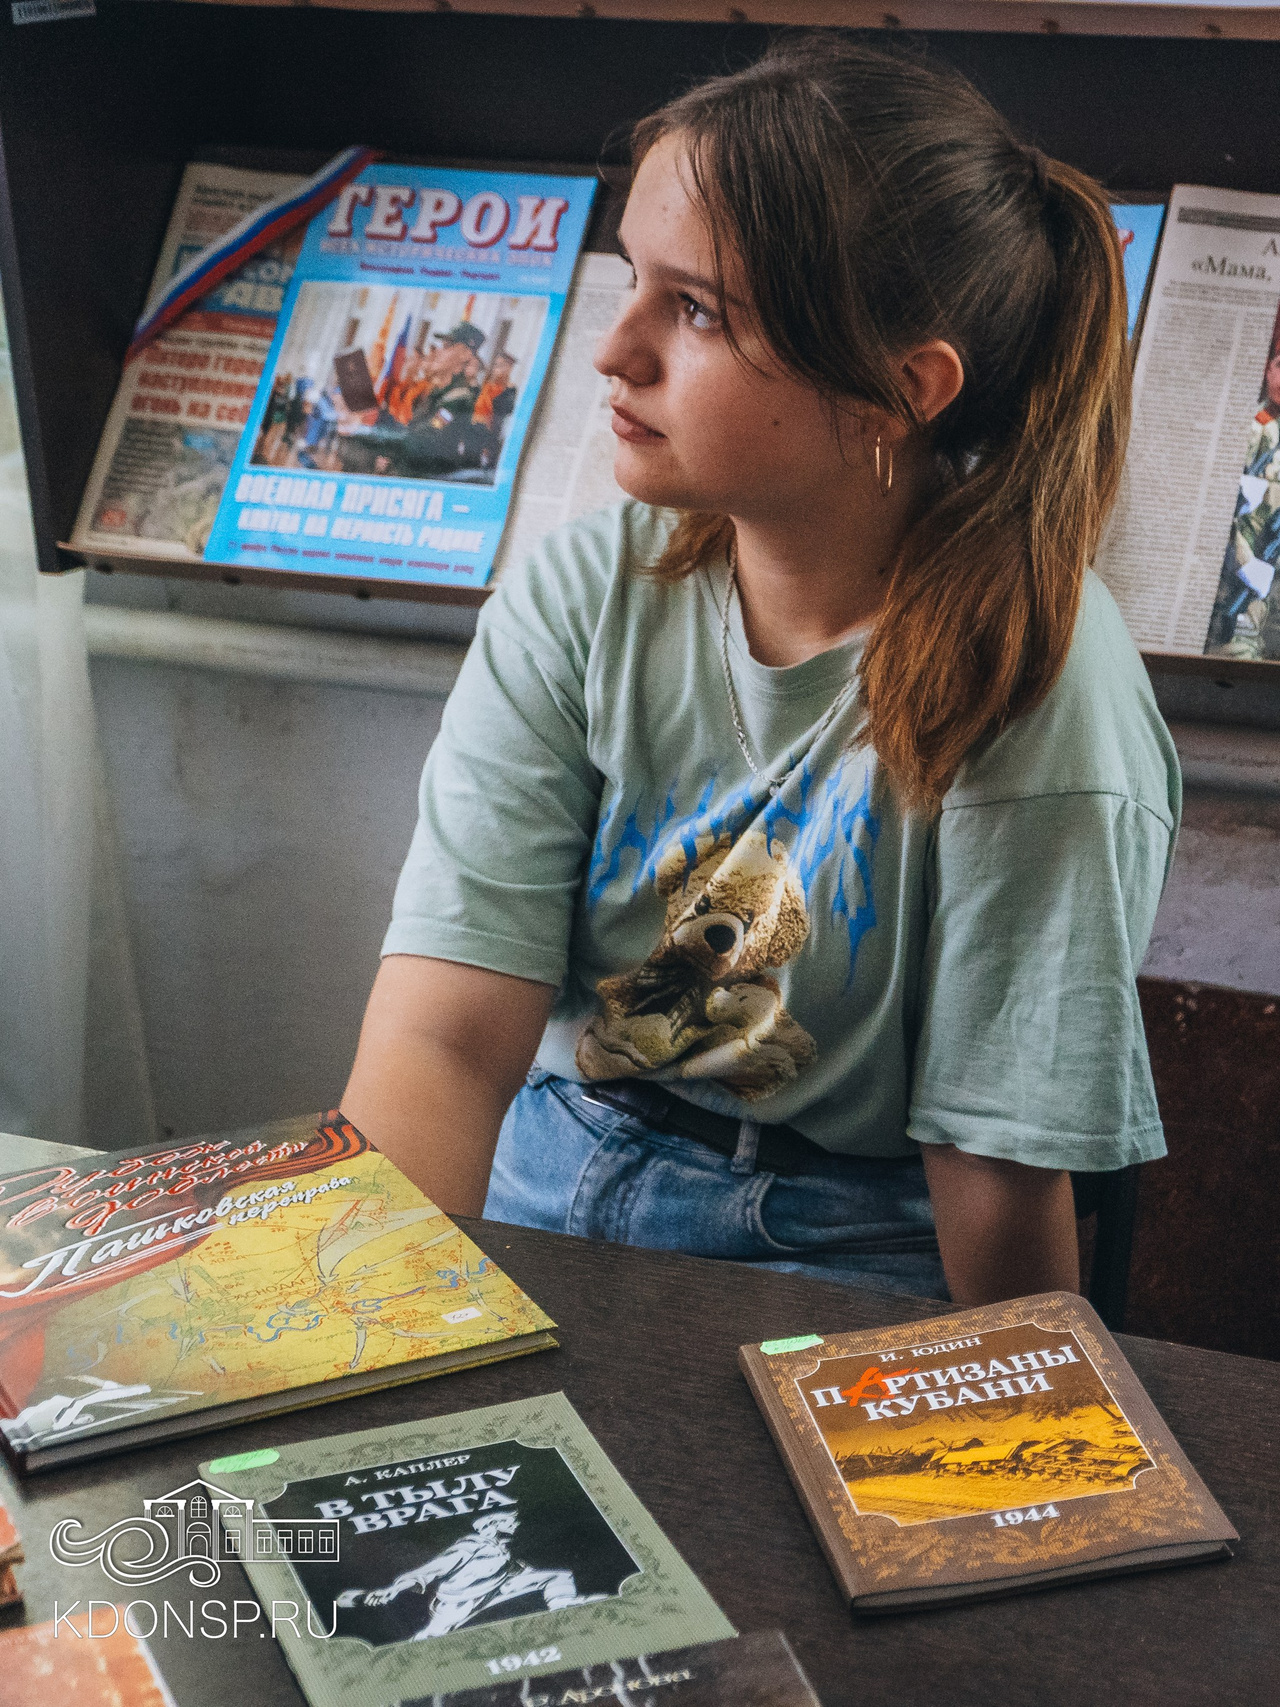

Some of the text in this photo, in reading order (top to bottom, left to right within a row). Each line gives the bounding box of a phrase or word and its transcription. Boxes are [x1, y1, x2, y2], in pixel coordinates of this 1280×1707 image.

[326, 183, 569, 253] ГЕРОИ
[228, 1175, 352, 1225] переправа
[0, 1180, 298, 1298] Пашковская
[879, 1336, 983, 1363] И. ЮДИН
[810, 1345, 1082, 1409] ПАРТИЗАНЫ
[860, 1372, 1054, 1422] КУБАНИ
[314, 1464, 521, 1520] В ТЫЛУ
[344, 1454, 471, 1487] А. КАПЛЕР
[347, 1490, 519, 1535] ВРАГА
[988, 1504, 1061, 1530] 1944
[485, 1645, 562, 1677] 1942
